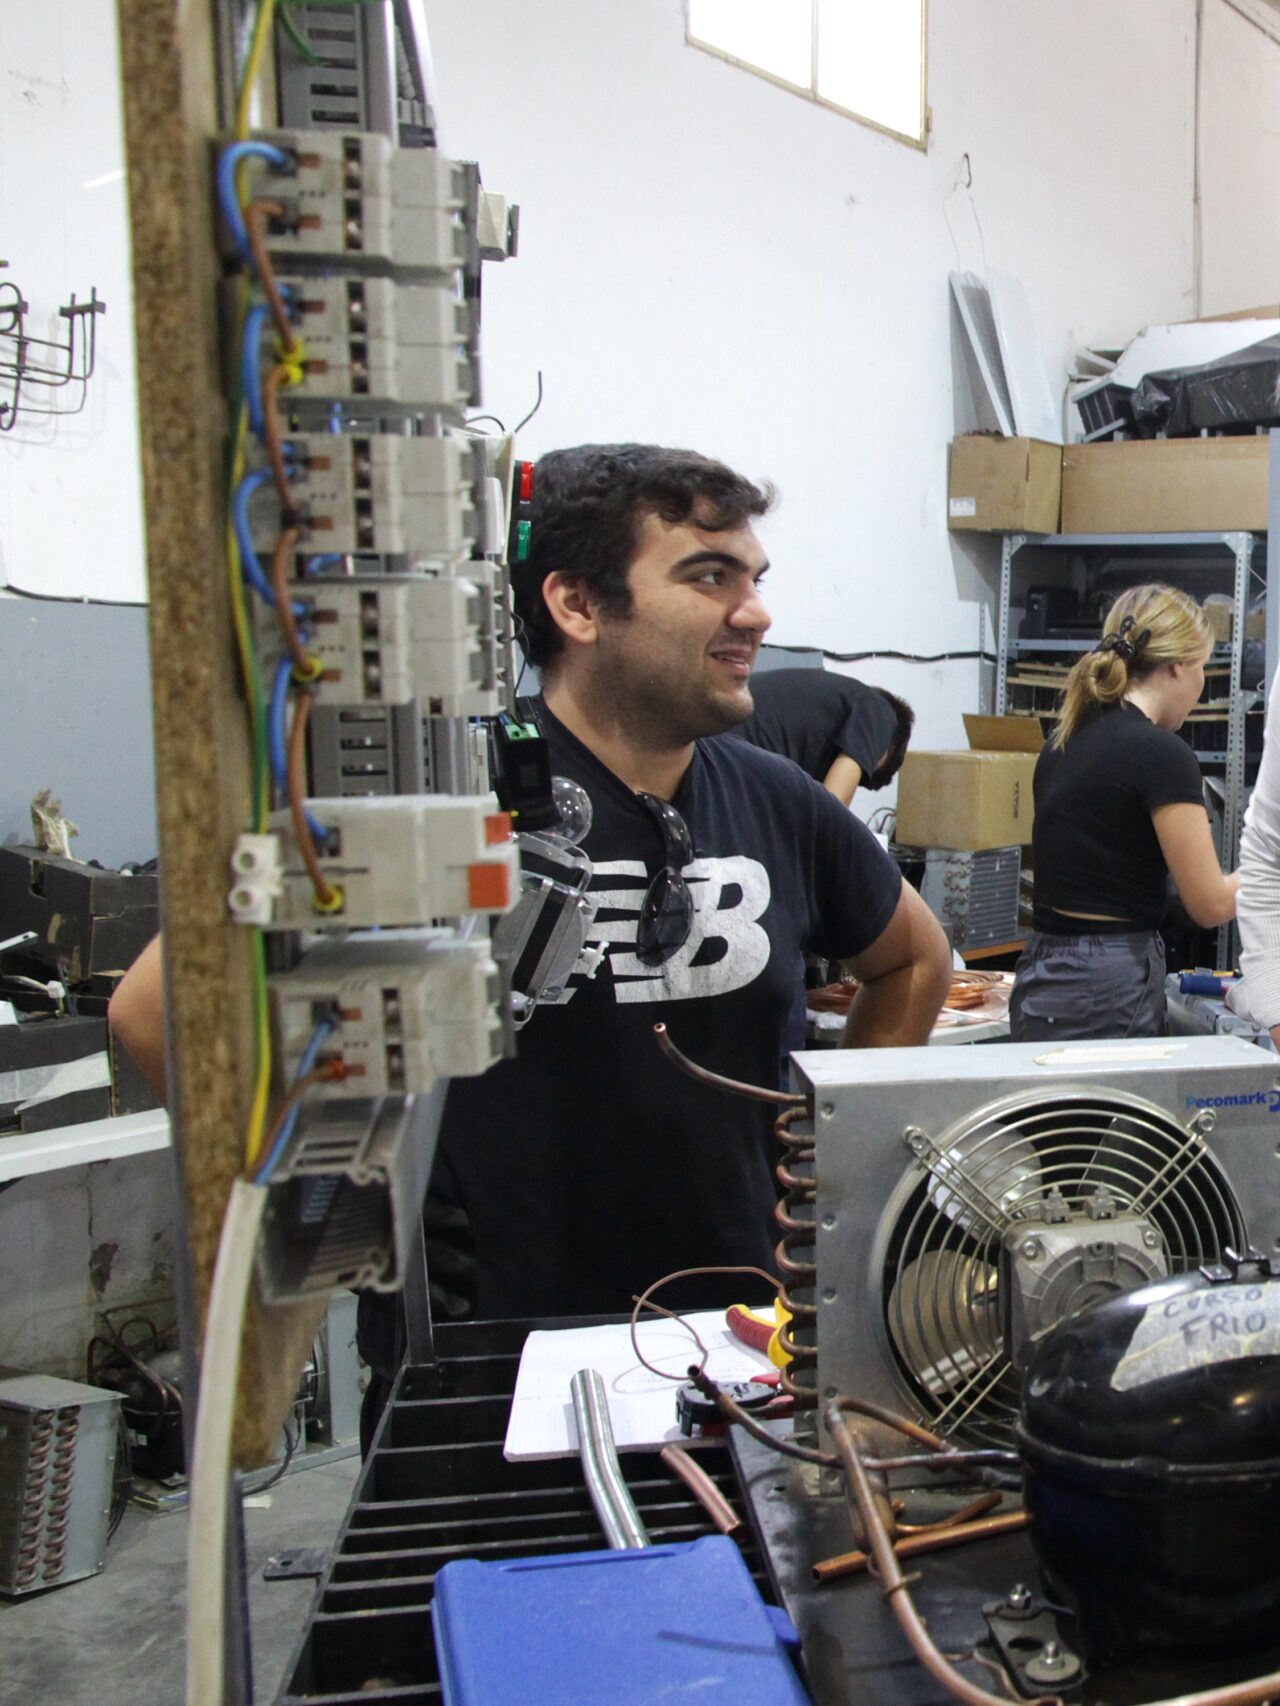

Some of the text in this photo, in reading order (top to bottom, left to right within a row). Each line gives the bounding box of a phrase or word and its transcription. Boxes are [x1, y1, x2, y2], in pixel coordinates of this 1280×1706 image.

[1185, 1092, 1267, 1109] Pecomark
[1164, 1287, 1263, 1318] CURSO
[1179, 1311, 1267, 1346] FRIO
